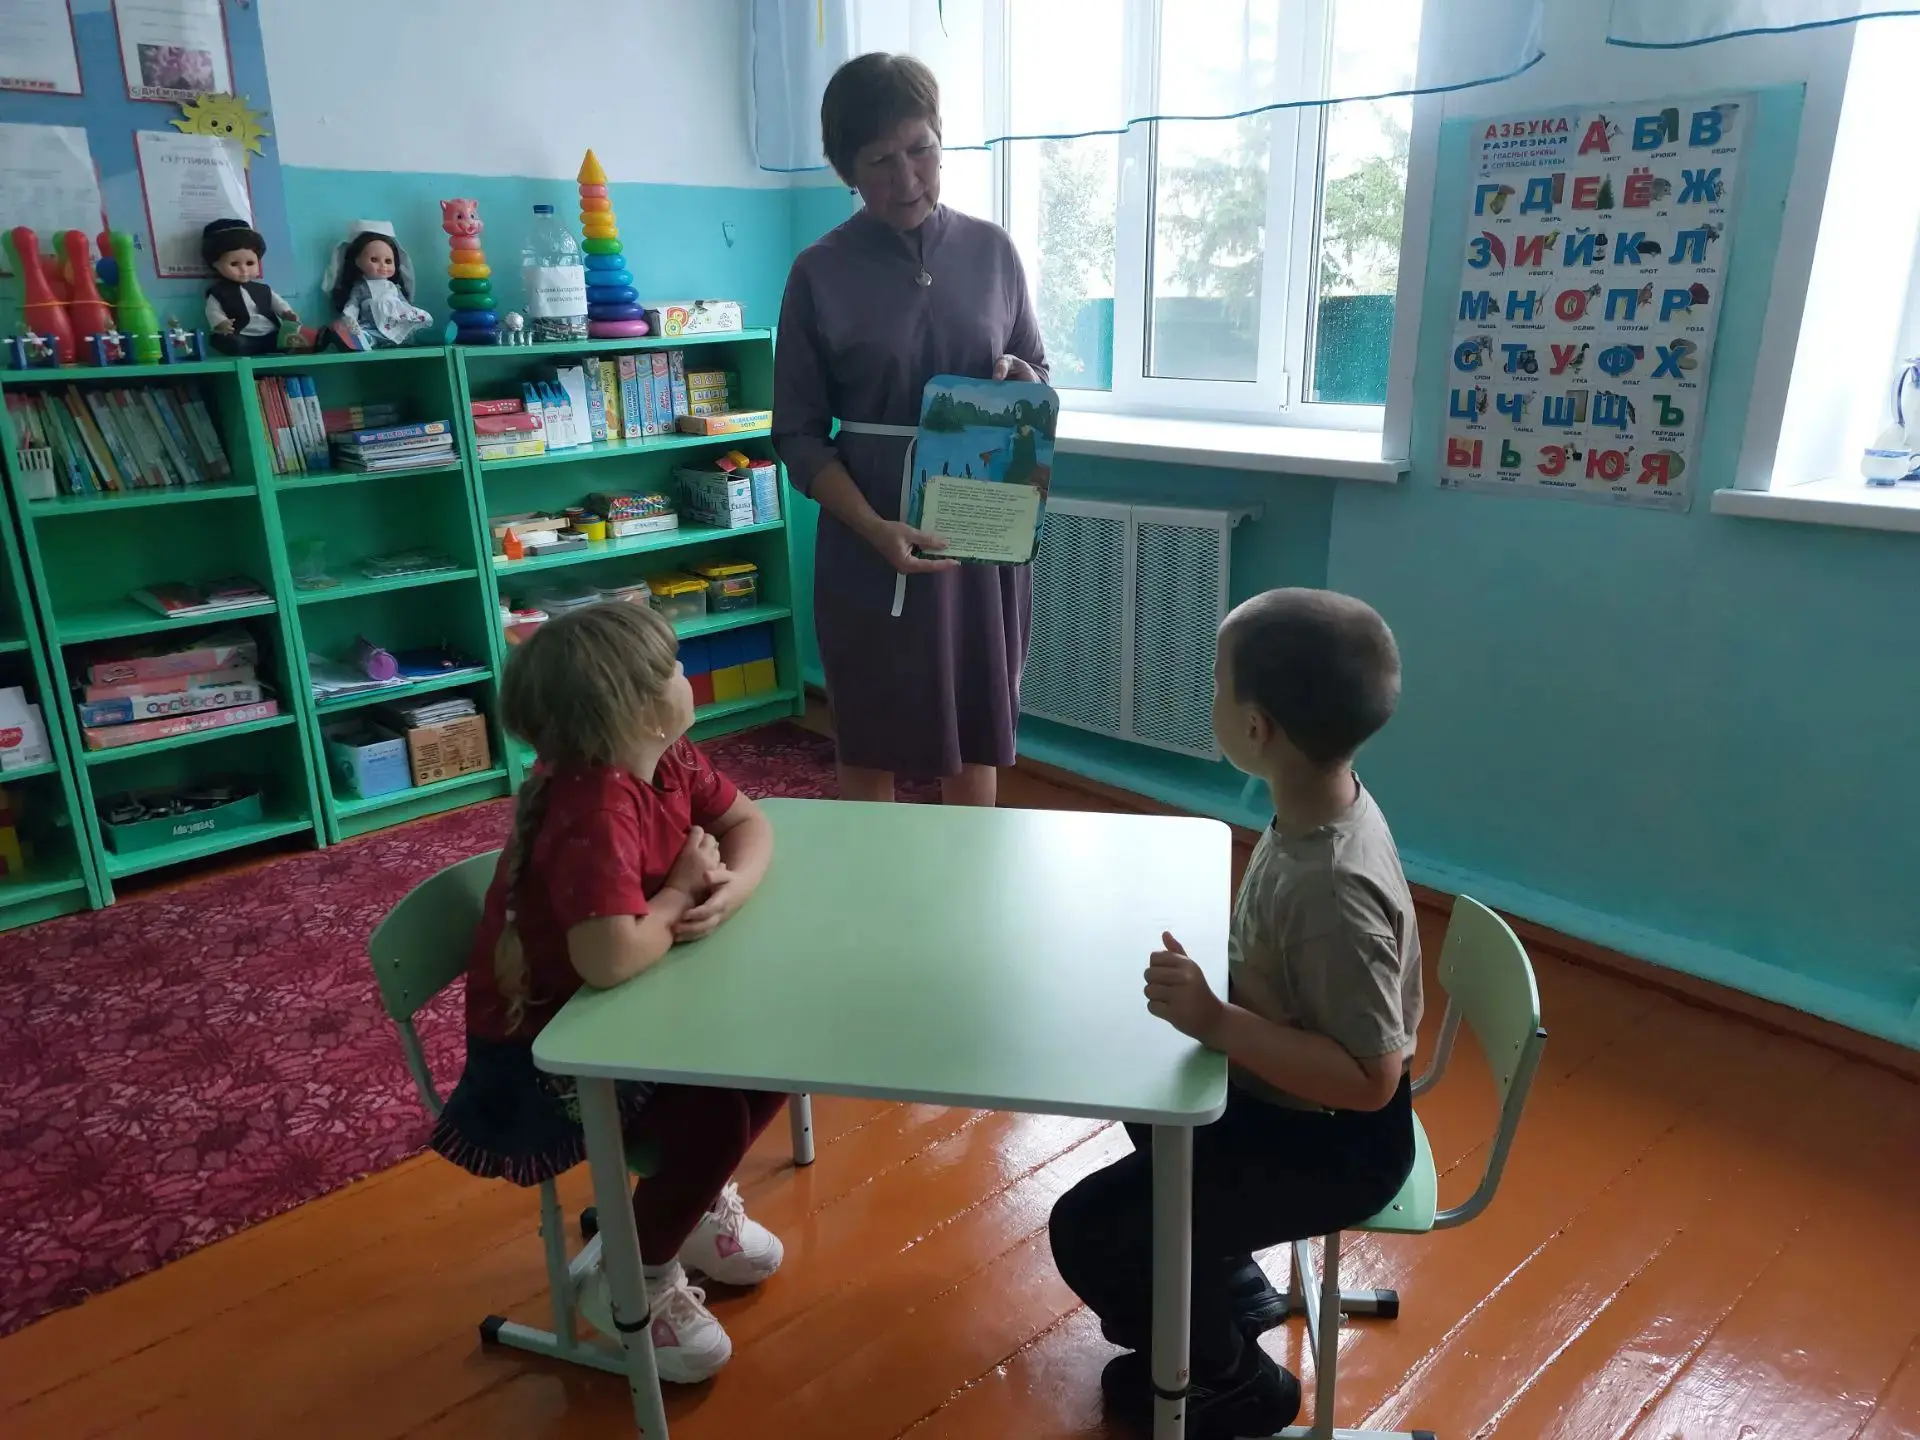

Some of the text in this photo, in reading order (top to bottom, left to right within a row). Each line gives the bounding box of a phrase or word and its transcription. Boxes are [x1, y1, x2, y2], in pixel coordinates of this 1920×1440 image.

[1483, 136, 1568, 150] РАЗРЕЗНАЯ
[1485, 118, 1569, 139] АЗБУКА
[1578, 111, 1723, 156] А Б В
[1491, 160, 1537, 170] СОГЛАСНЫЕ
[1493, 148, 1557, 160] ГЛАСНЫЕ БУКВЫ
[1474, 166, 1722, 216] Г Д Е Ё Ж
[1468, 226, 1708, 270] З И Й К Л
[1459, 288, 1692, 322] М Н О П Р
[1454, 341, 1690, 381] С Т У Ф Х
[1449, 388, 1685, 432] Ц Ч Ш Щ Ъ
[1447, 437, 1671, 486] Ы Ь Э Ю Я
